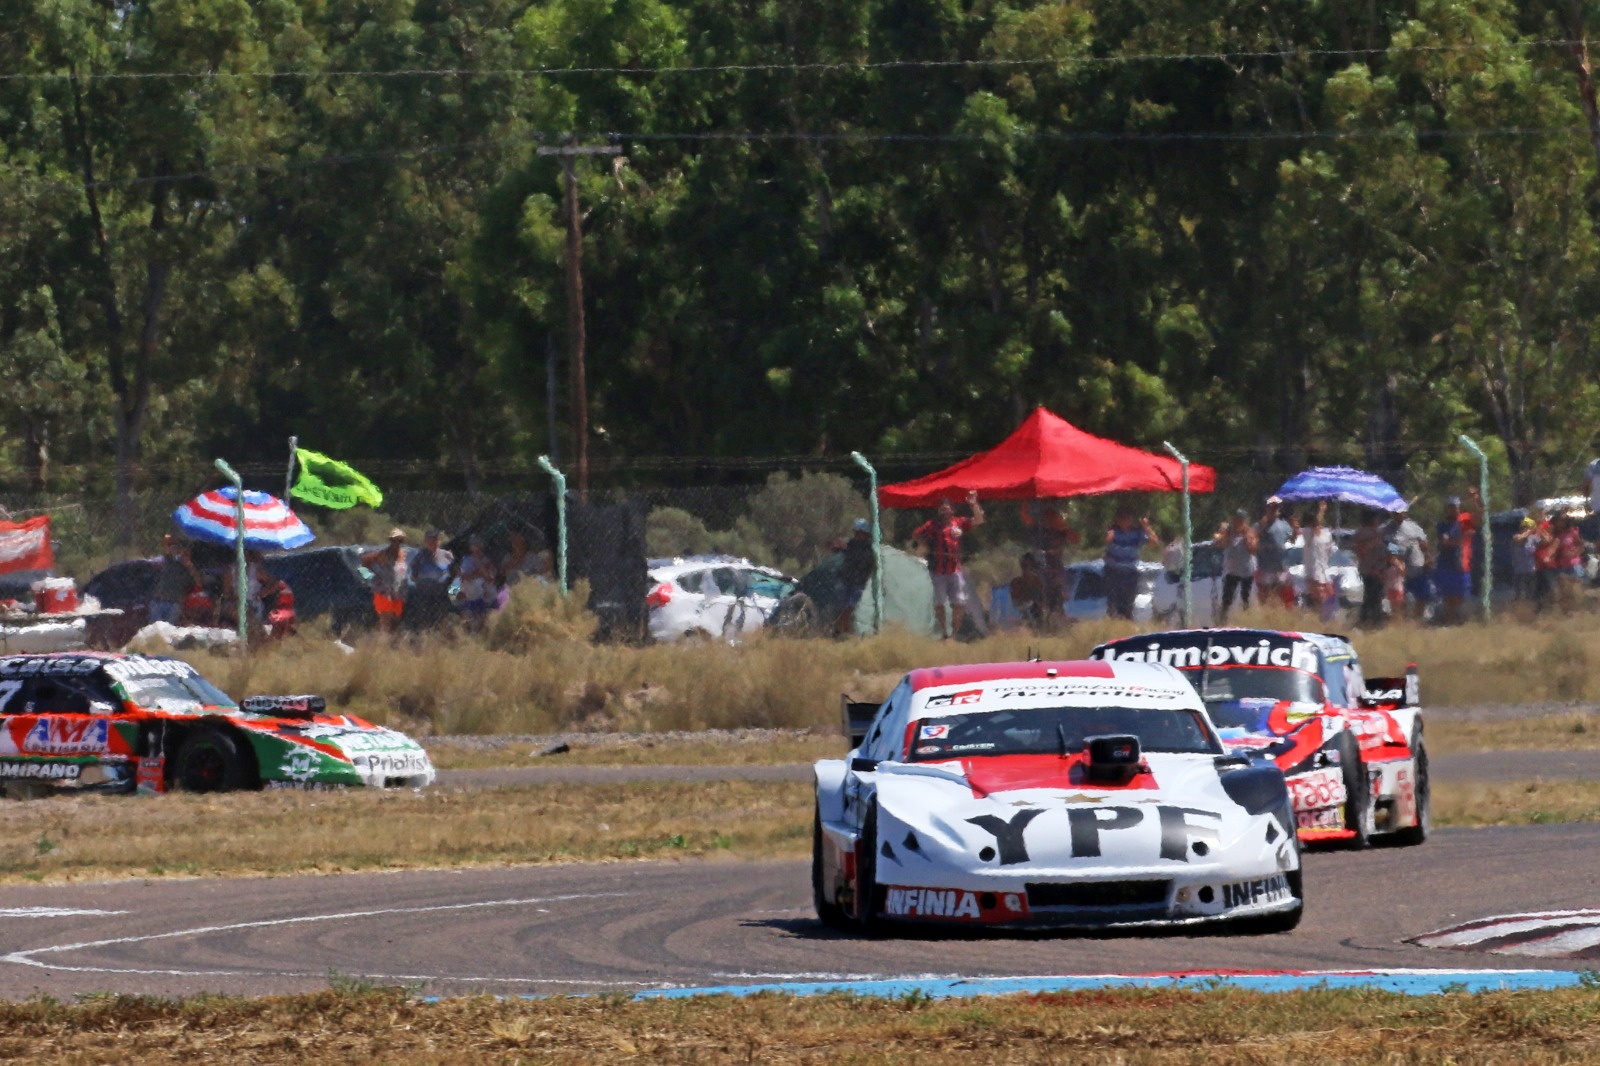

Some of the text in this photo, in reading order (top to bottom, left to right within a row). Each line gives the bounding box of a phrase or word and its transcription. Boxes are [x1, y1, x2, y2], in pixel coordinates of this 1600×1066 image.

[1000, 690, 1176, 699] Argentina
[0, 762, 79, 778] MIRANO
[964, 805, 1222, 866] YPF
[887, 888, 981, 918] INFINIA
